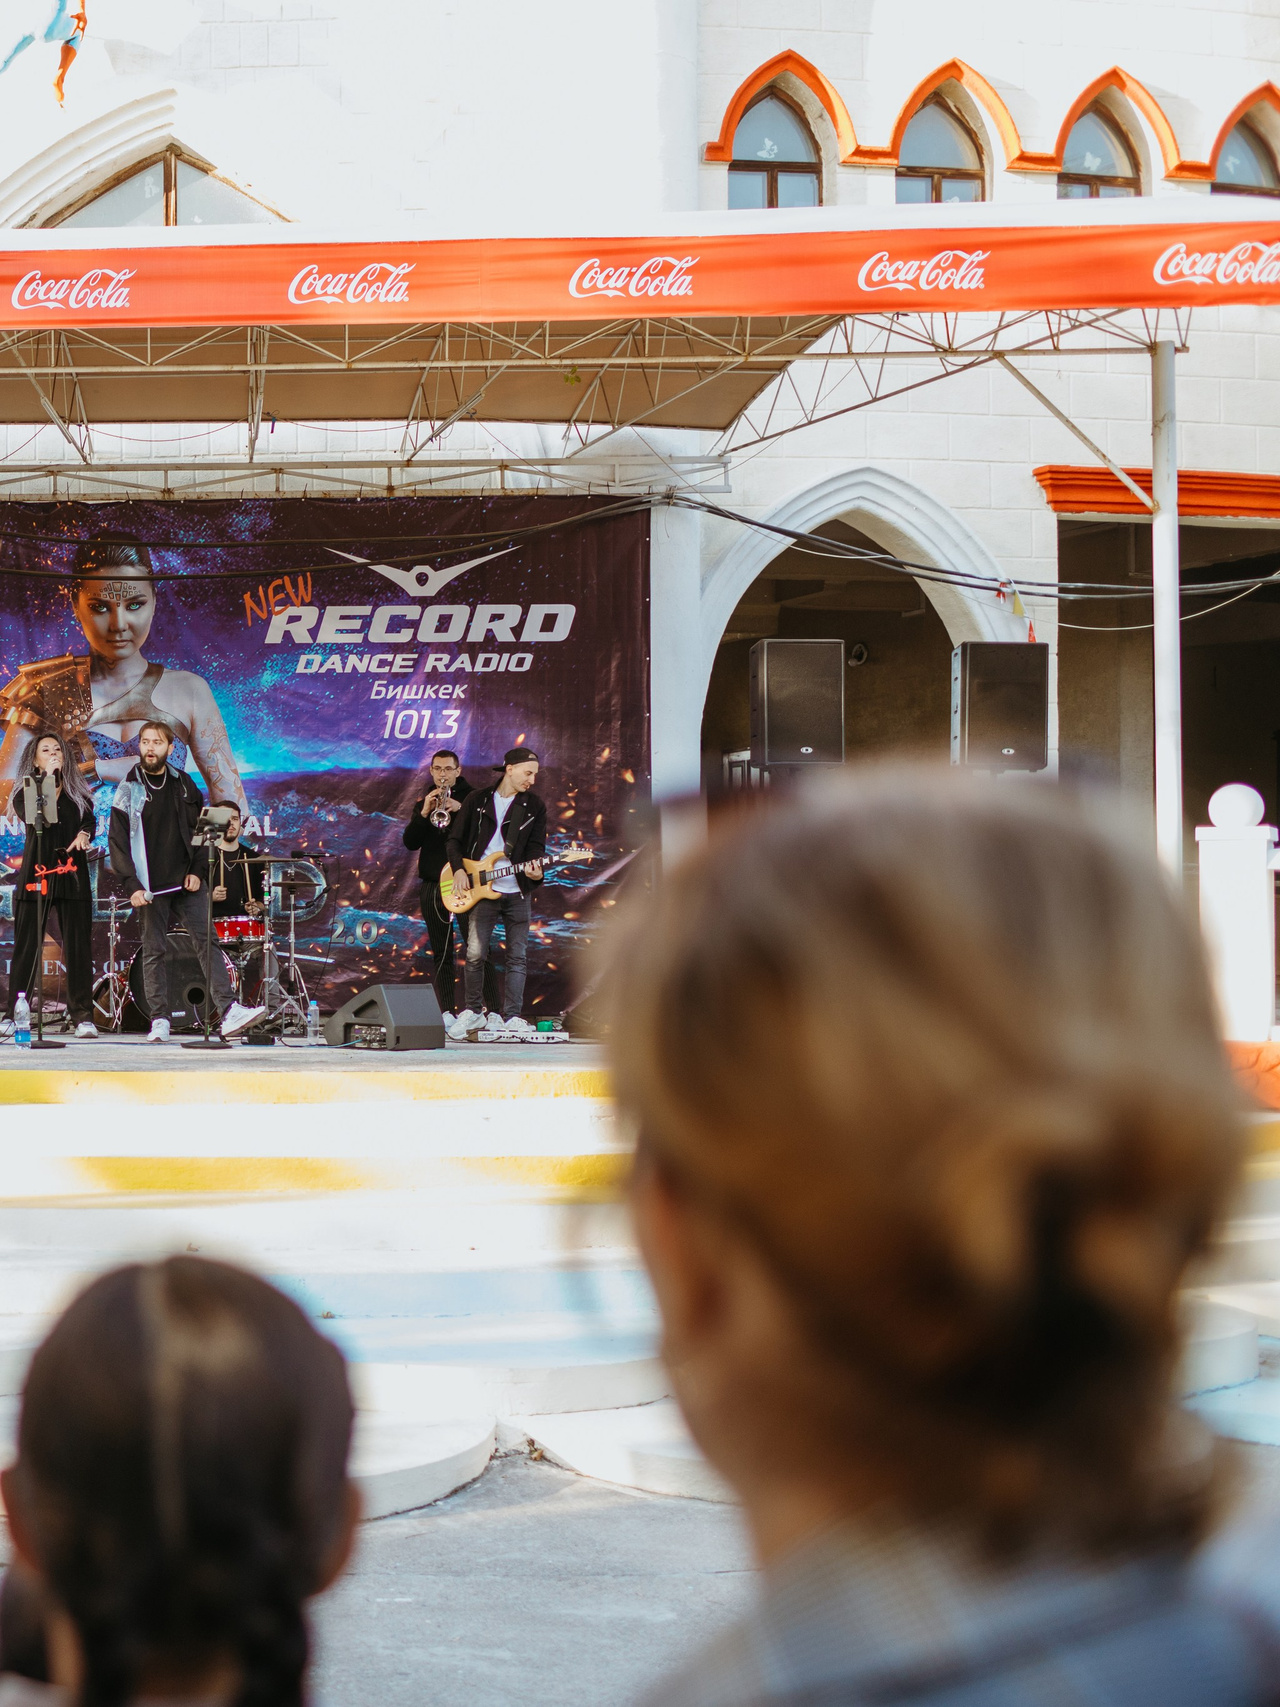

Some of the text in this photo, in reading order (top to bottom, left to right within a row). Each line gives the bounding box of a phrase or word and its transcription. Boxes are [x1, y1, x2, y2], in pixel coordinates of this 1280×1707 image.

[10, 269, 136, 309] Coca-Cola
[287, 263, 417, 304] Coca-Cola
[568, 256, 700, 298] Coca-Cola
[857, 250, 992, 292] Coca-Cola
[243, 572, 312, 627] NEW
[264, 604, 577, 644] RECORD
[296, 653, 534, 673] DANCE RADIO
[370, 680, 468, 699] Бишкек
[383, 709, 461, 739] 101.3
[328, 918, 379, 945] 2.0
